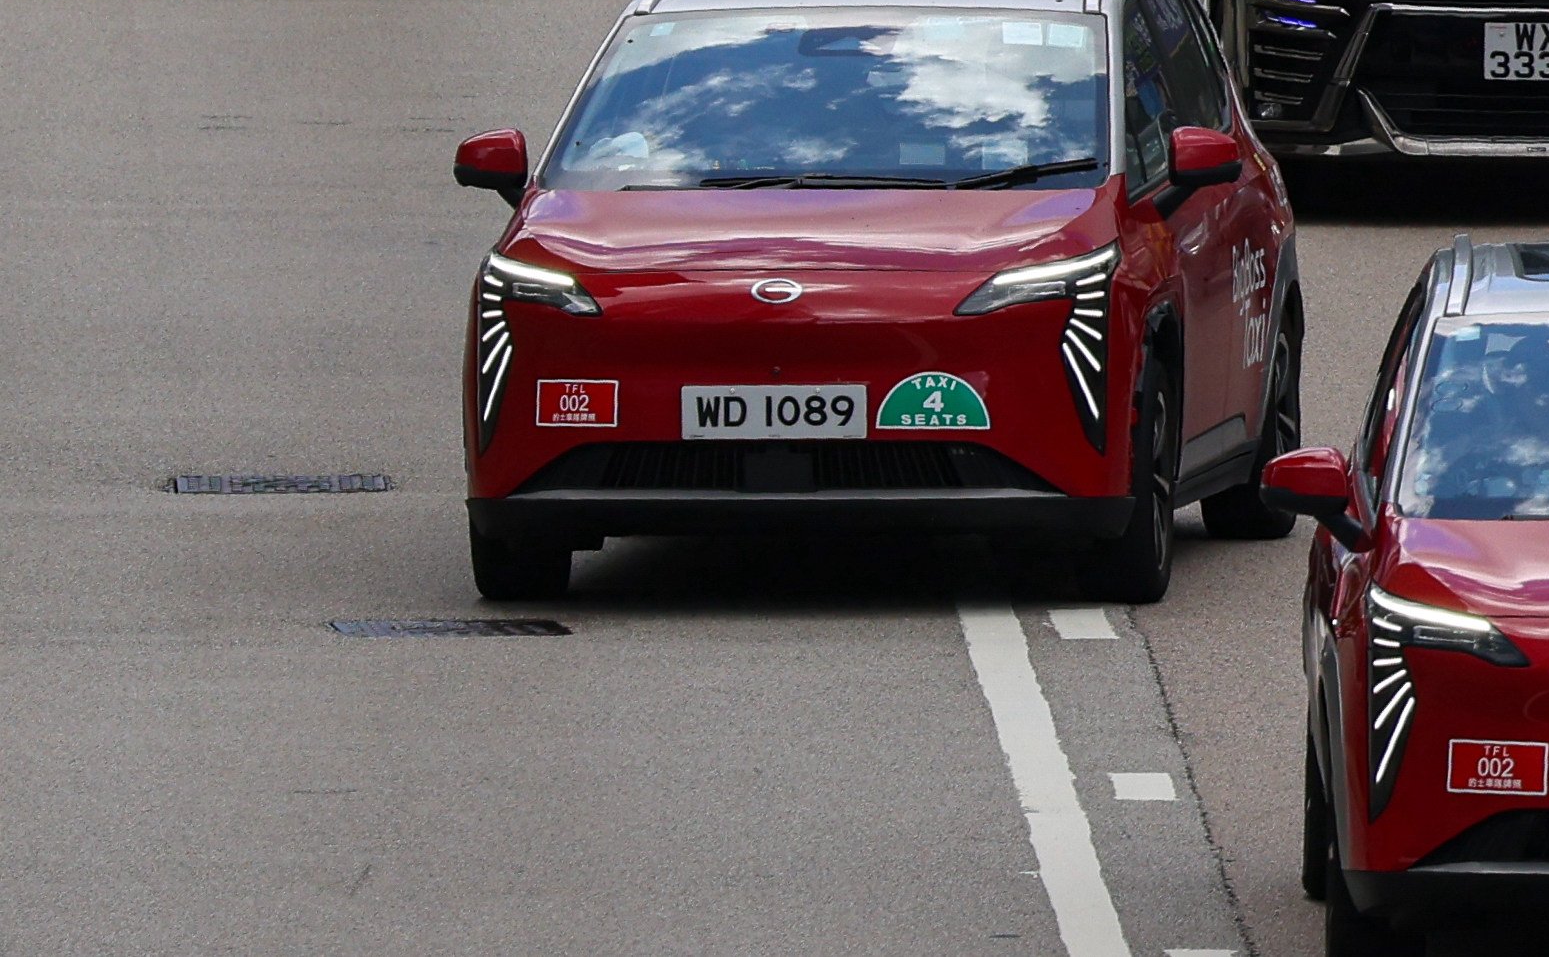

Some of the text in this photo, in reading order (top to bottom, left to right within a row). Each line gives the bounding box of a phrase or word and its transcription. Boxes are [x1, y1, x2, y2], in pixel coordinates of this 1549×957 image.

[1241, 297, 1266, 369] Taxi
[564, 384, 586, 394] TFL
[911, 376, 957, 390] TAXI
[560, 395, 589, 411] 002
[923, 390, 944, 412] 4
[697, 395, 854, 428] WD 1089
[901, 414, 967, 425] SEATS
[1484, 745, 1510, 757] TFL
[1477, 757, 1514, 777] 002
